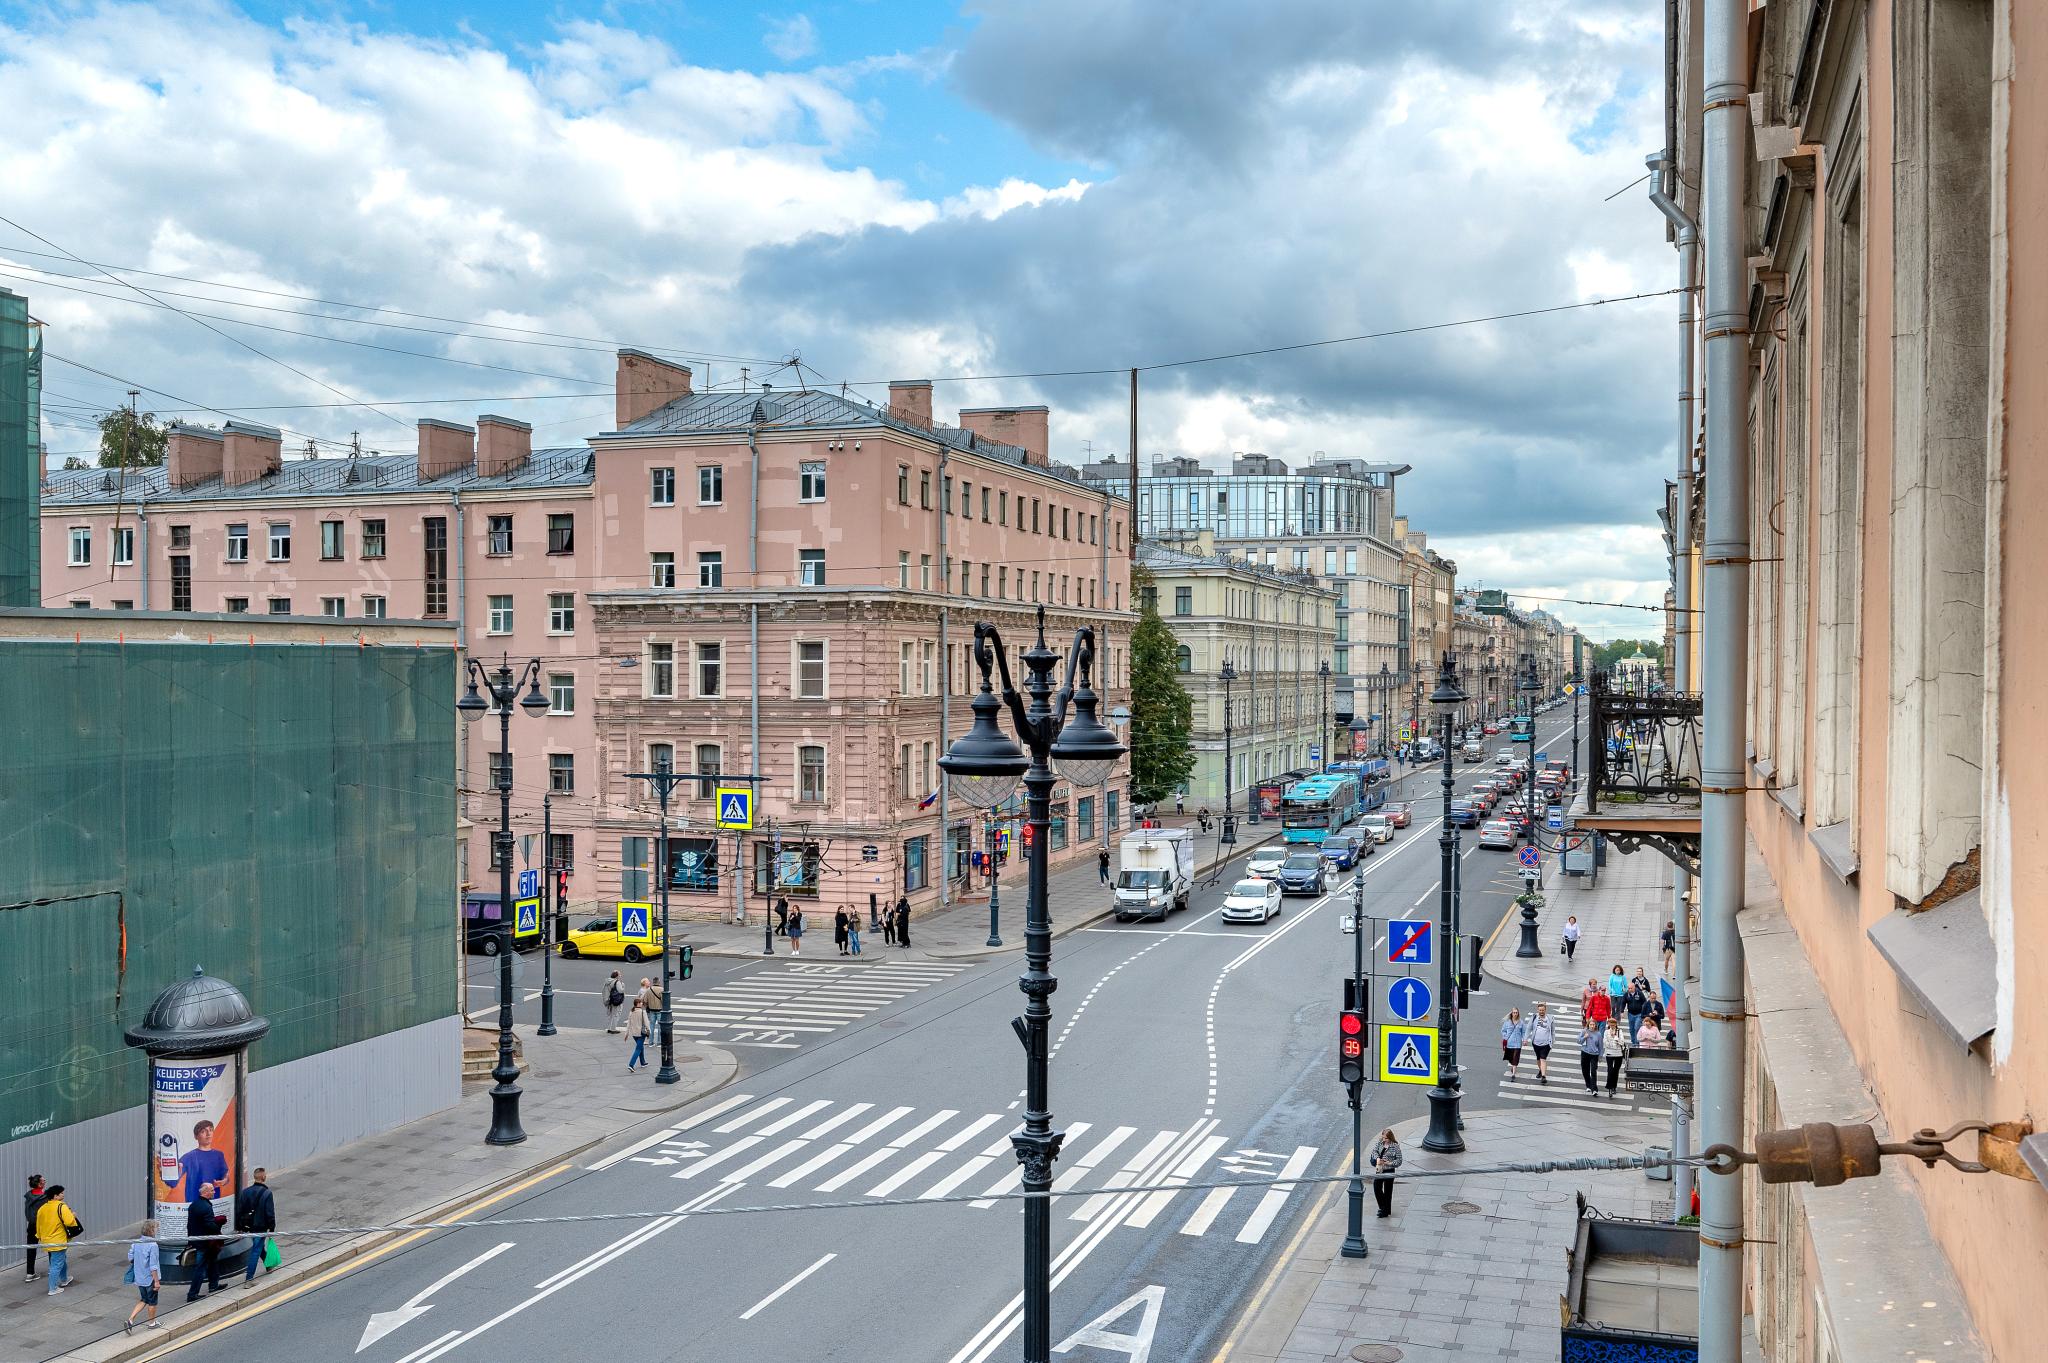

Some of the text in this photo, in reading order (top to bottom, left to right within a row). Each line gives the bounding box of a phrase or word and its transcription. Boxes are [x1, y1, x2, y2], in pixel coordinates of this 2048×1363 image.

[1345, 1040, 1360, 1055] 39
[156, 1067, 218, 1079] КЕШБЭК 3%
[156, 1080, 194, 1090] В ЛЕНТЕ
